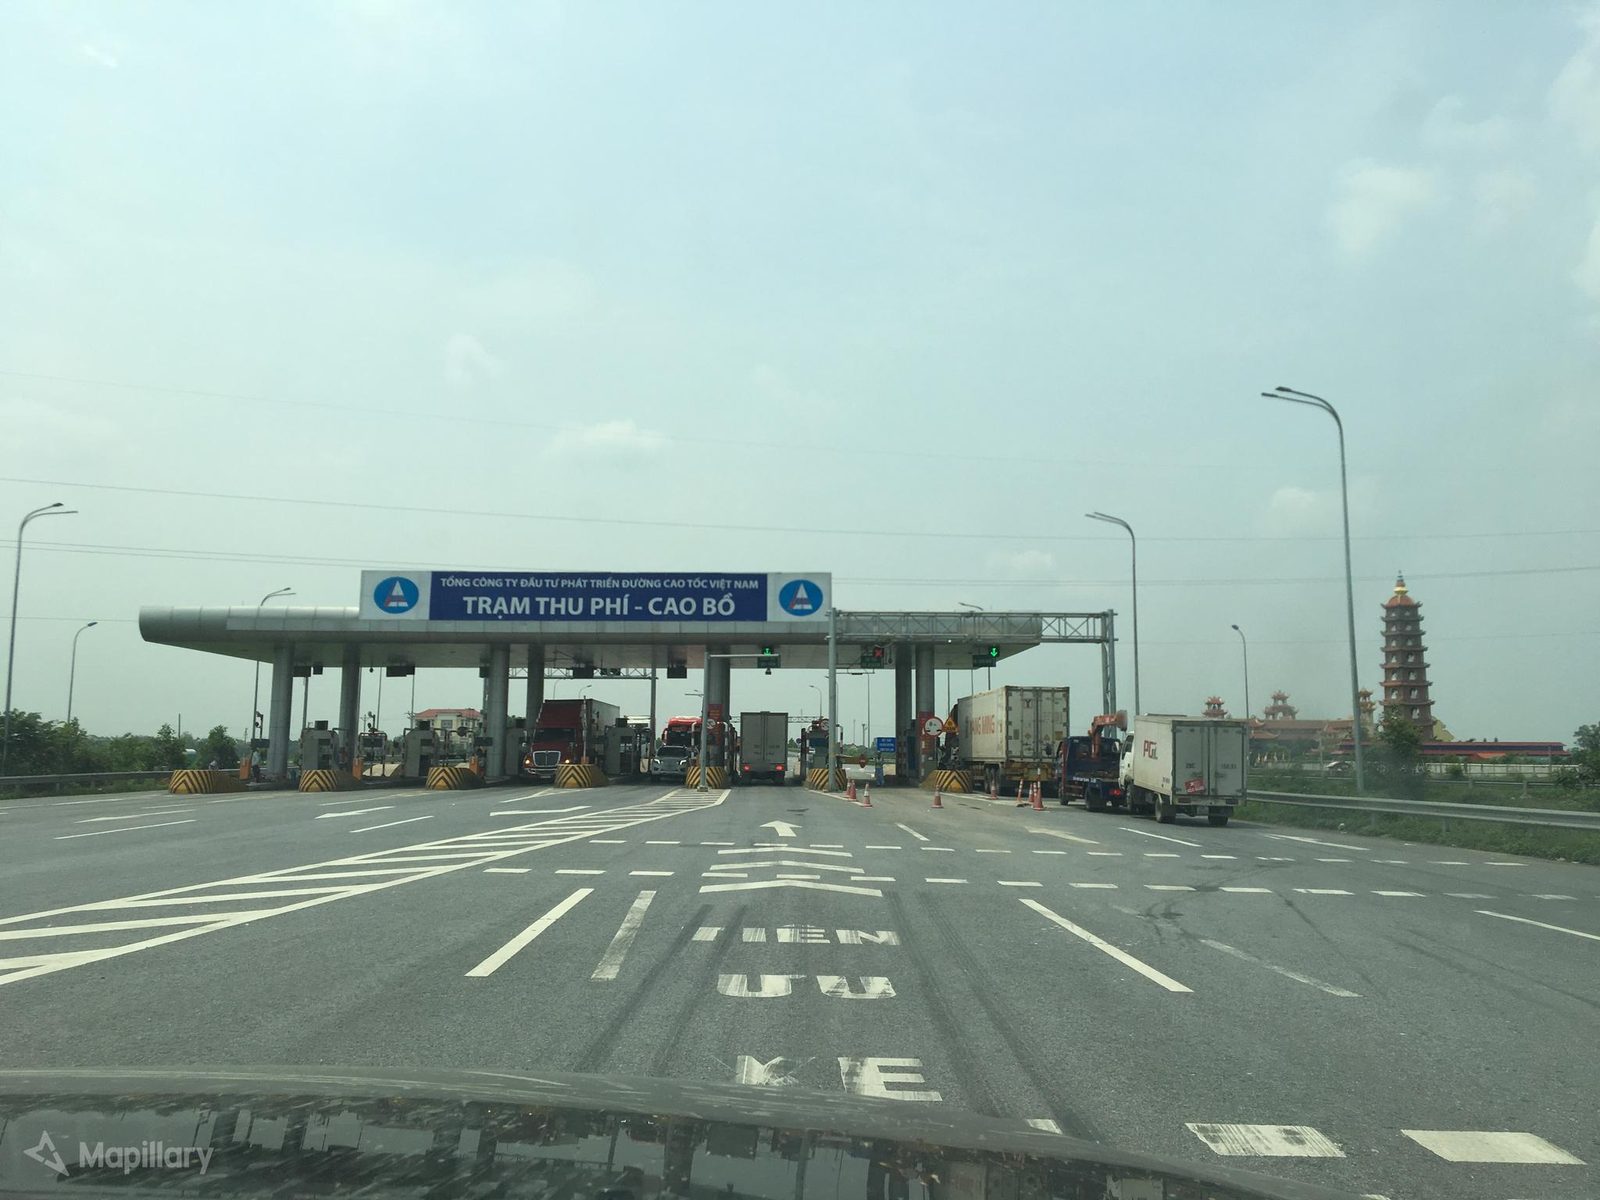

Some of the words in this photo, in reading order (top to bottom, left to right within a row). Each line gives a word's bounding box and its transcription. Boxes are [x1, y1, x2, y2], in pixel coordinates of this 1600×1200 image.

[472, 576, 503, 588] CÔNG
[504, 578, 518, 588] TY
[561, 577, 588, 588] PHÁT
[663, 579, 686, 589] CAO
[733, 579, 759, 589] NAM
[462, 596, 530, 619] TRẠM
[535, 597, 584, 615] THU
[590, 593, 630, 615] PHÍ
[648, 597, 697, 616] CAO
